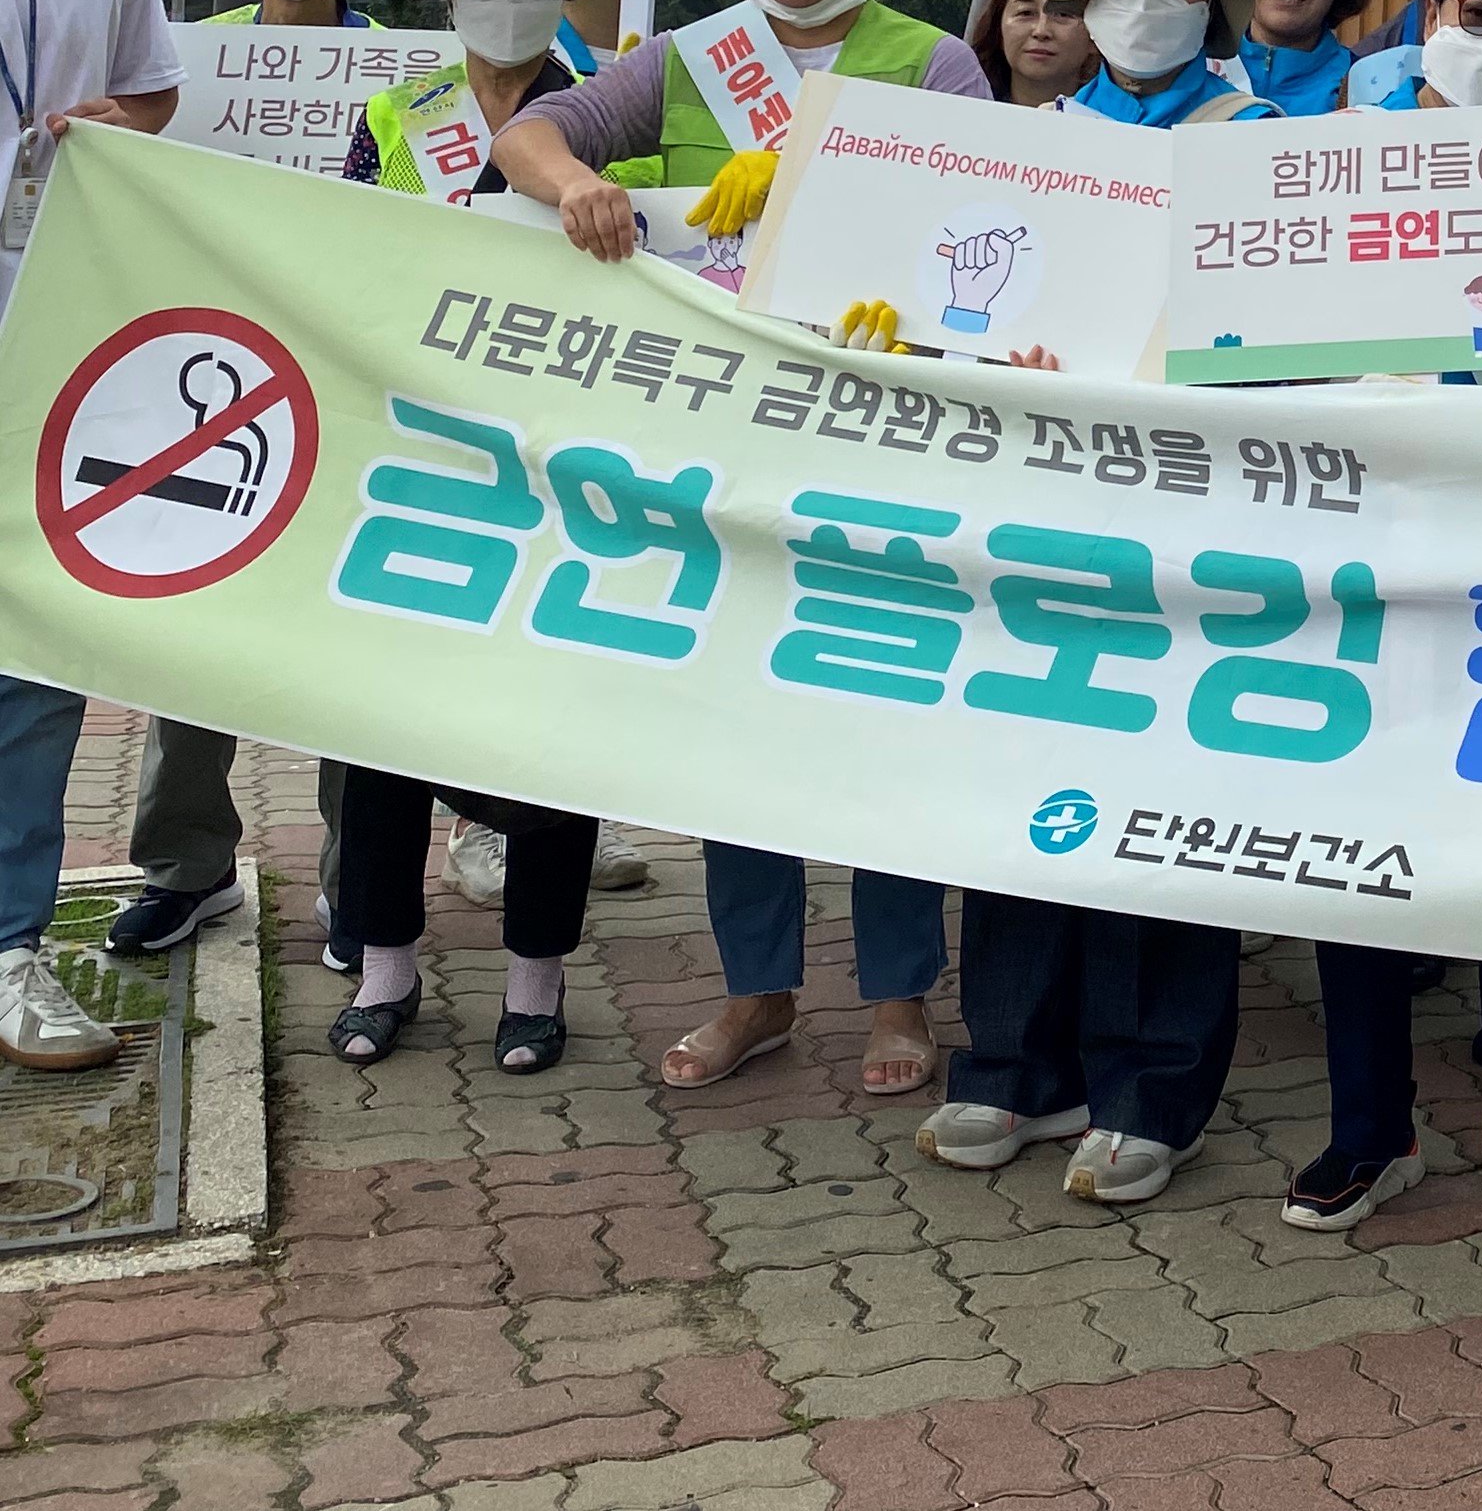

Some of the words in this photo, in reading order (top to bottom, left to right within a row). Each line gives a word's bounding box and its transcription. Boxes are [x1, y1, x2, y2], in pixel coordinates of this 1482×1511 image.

[216, 44, 302, 83] 나와
[820, 125, 924, 166] Давайте
[928, 141, 1017, 182] бросим
[1021, 164, 1102, 197] курить
[1272, 146, 1363, 198] 함께
[1194, 214, 1333, 270] 건강한
[420, 287, 745, 414] 다문화특구
[751, 359, 1001, 465] 금연환경
[1023, 411, 1213, 498] 조성을
[1237, 436, 1367, 515] 위한
[337, 395, 722, 660] 금연
[770, 490, 1386, 763] 플로깅
[1113, 807, 1416, 902] 단원보건소
